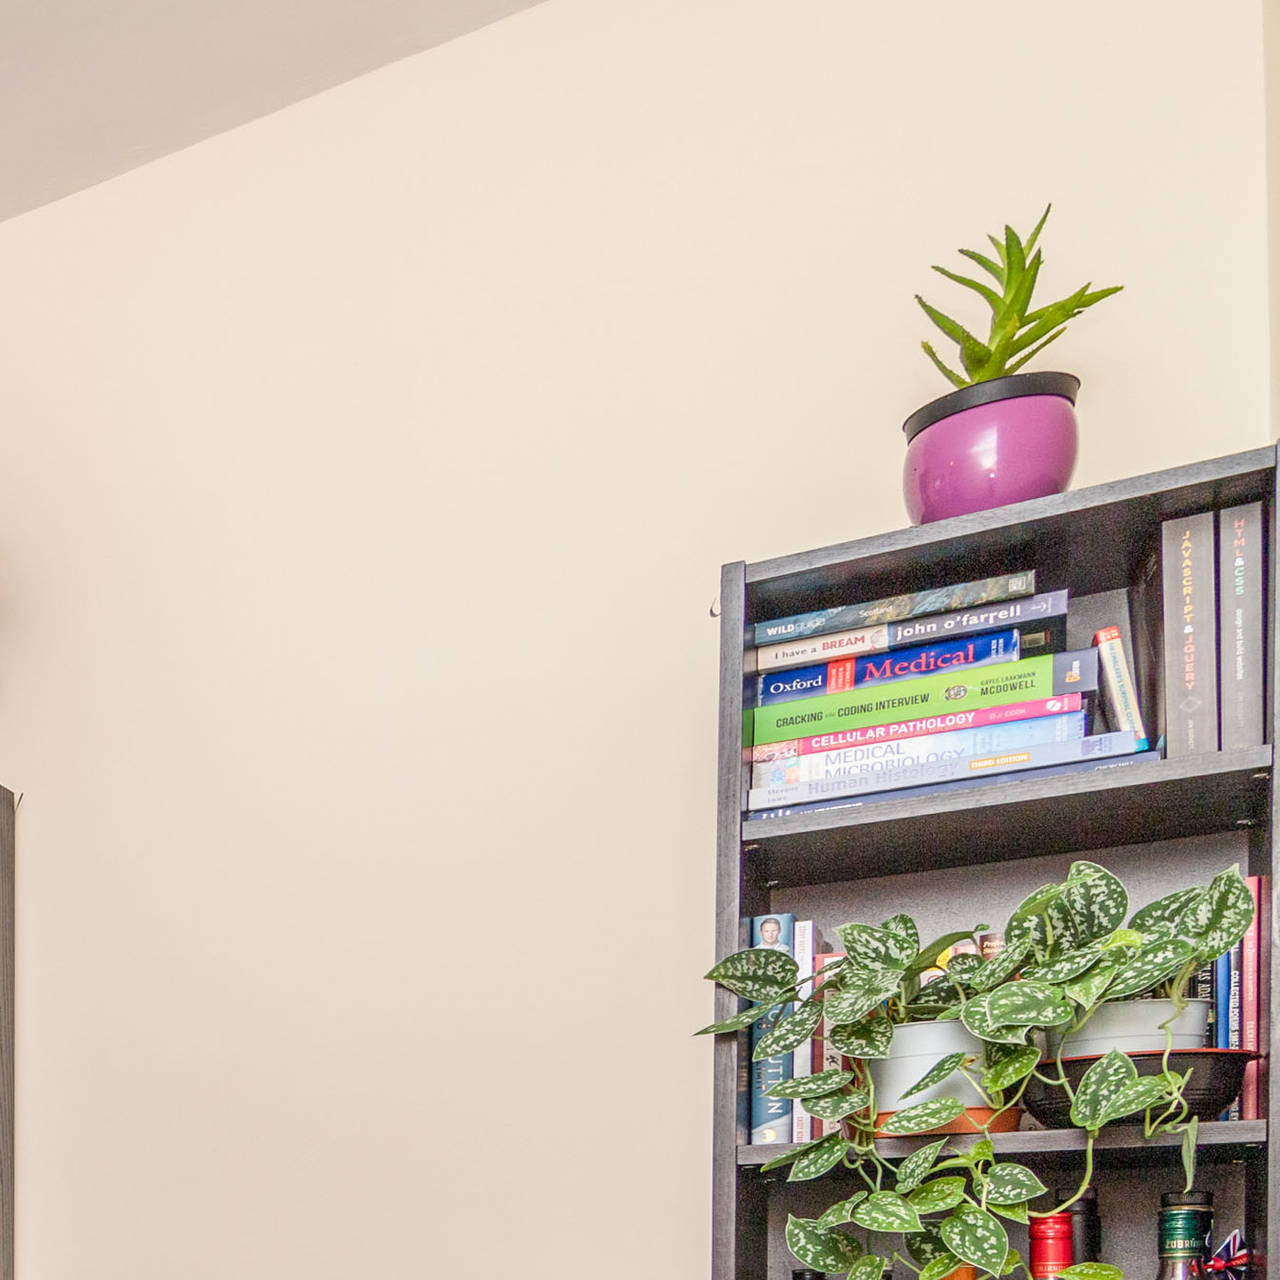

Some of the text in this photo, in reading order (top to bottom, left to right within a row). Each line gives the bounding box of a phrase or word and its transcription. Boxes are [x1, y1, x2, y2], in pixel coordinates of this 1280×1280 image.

[896, 604, 1022, 640] john o'farrell
[781, 648, 808, 658] have
[822, 635, 866, 652] BREAM
[769, 675, 823, 695] Oxford
[864, 644, 976, 682] Medical
[980, 680, 1036, 697] MCDOWELL
[776, 692, 930, 729] CRACKING CODING INTERVIEW
[811, 711, 976, 749] CELLULAR PATHOLOGY
[824, 742, 906, 767] MEDICAL
[808, 774, 870, 795] Human
